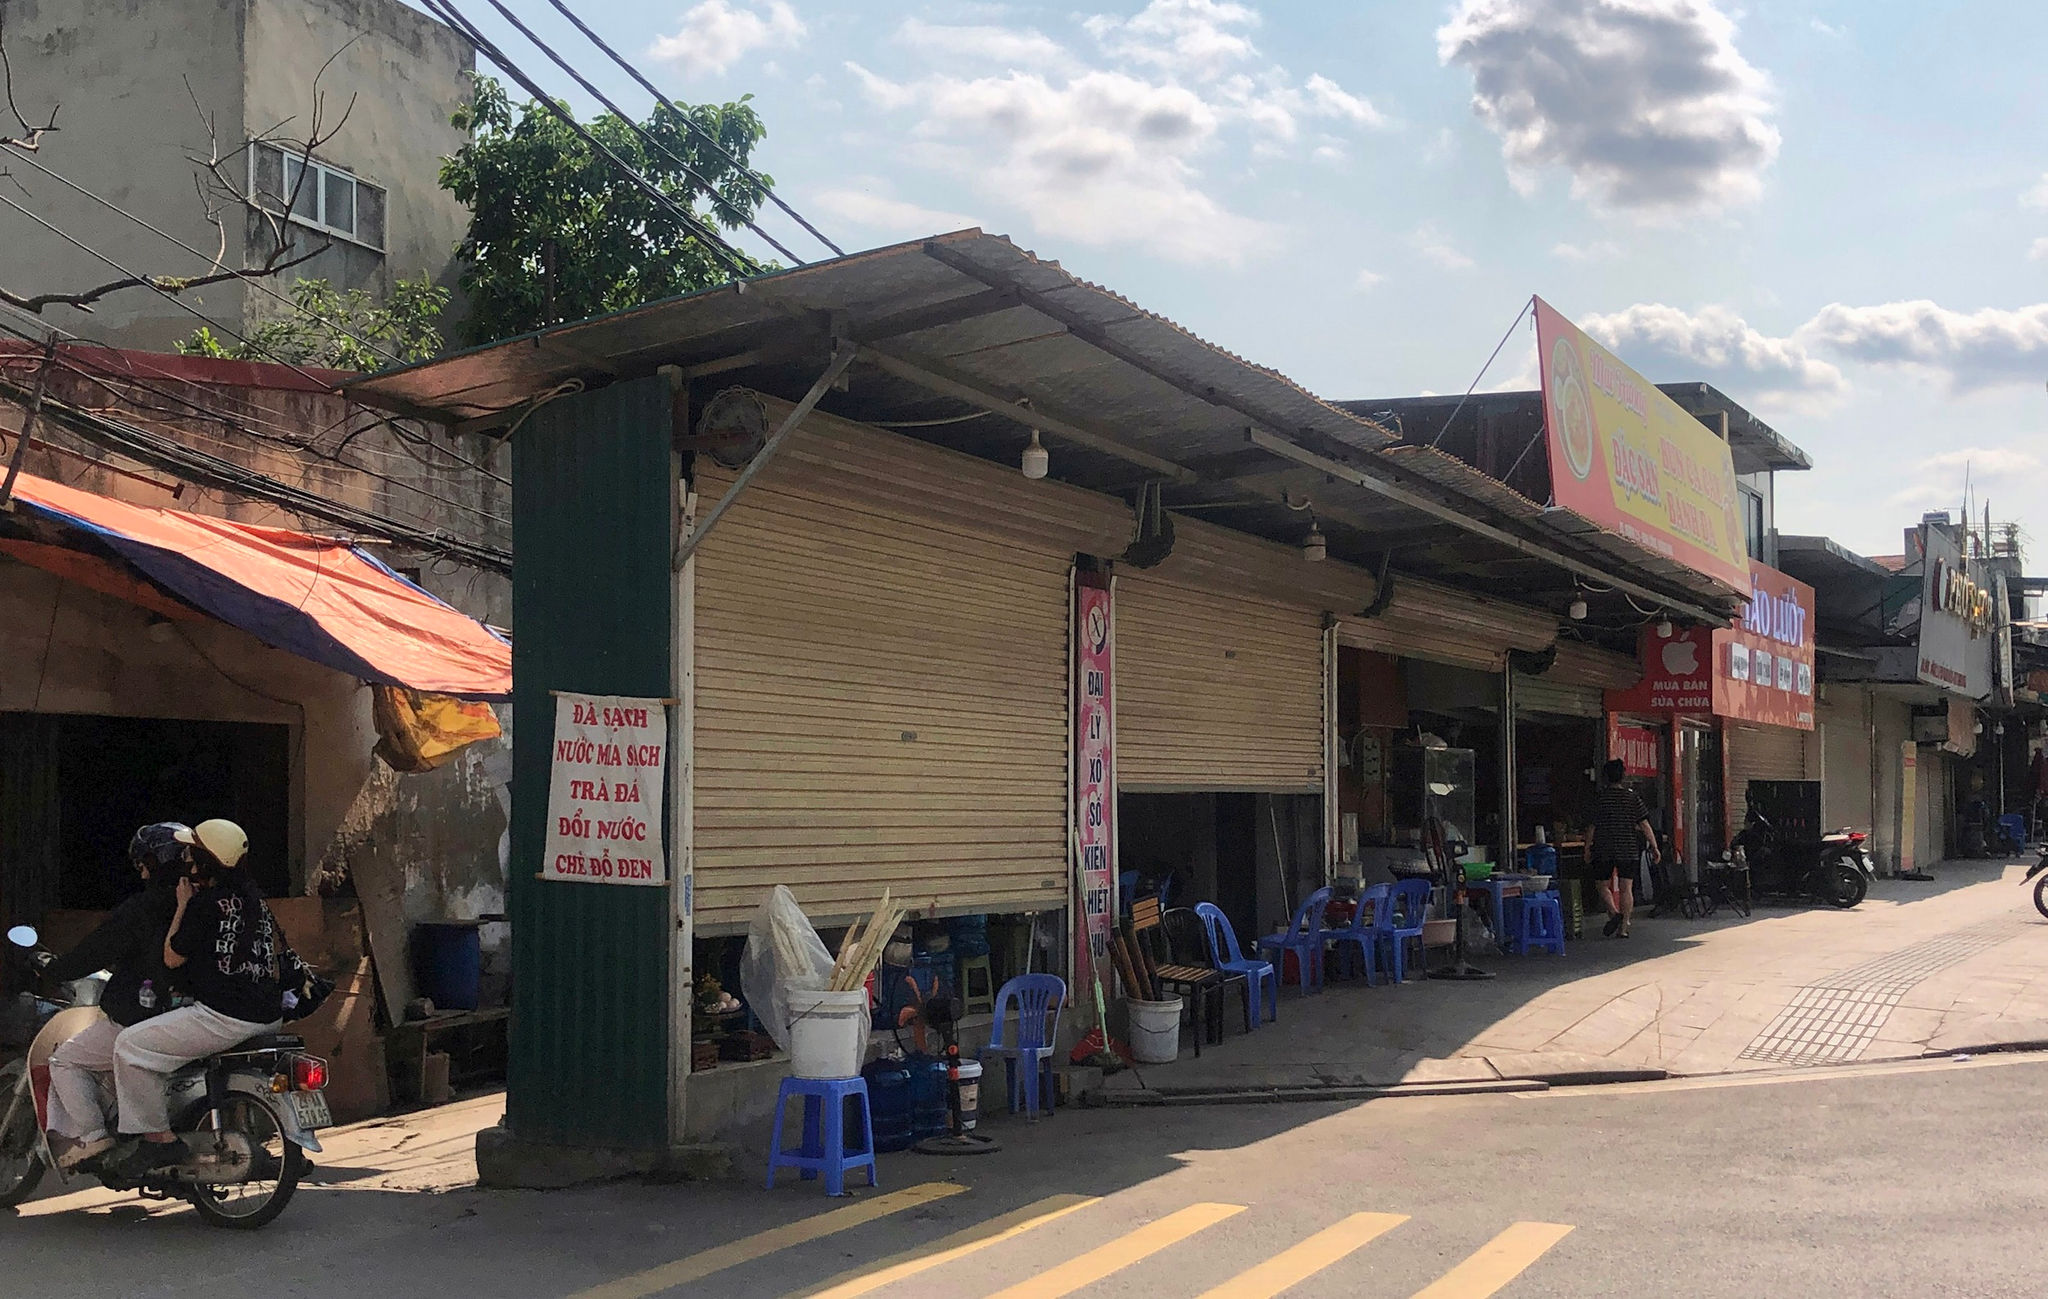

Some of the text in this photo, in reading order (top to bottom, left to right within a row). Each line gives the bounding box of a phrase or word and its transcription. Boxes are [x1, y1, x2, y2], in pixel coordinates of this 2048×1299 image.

[1087, 671, 1105, 704] ĐẠI
[1653, 680, 1680, 690] MUA
[603, 708, 648, 732] SẠCH
[1090, 710, 1102, 740] LÝ
[557, 737, 595, 763] NƯỚC
[627, 744, 661, 772] SẠCH
[571, 777, 640, 803] TRÀ ĐÁ
[559, 808, 646, 841] ĐỔI NƯỚC
[1089, 793, 1102, 827] SỐ
[556, 848, 653, 879] CHÈ ĐỖ ĐEN
[1084, 838, 1107, 871] KIẾN
[1086, 880, 1109, 915] HIẾT
